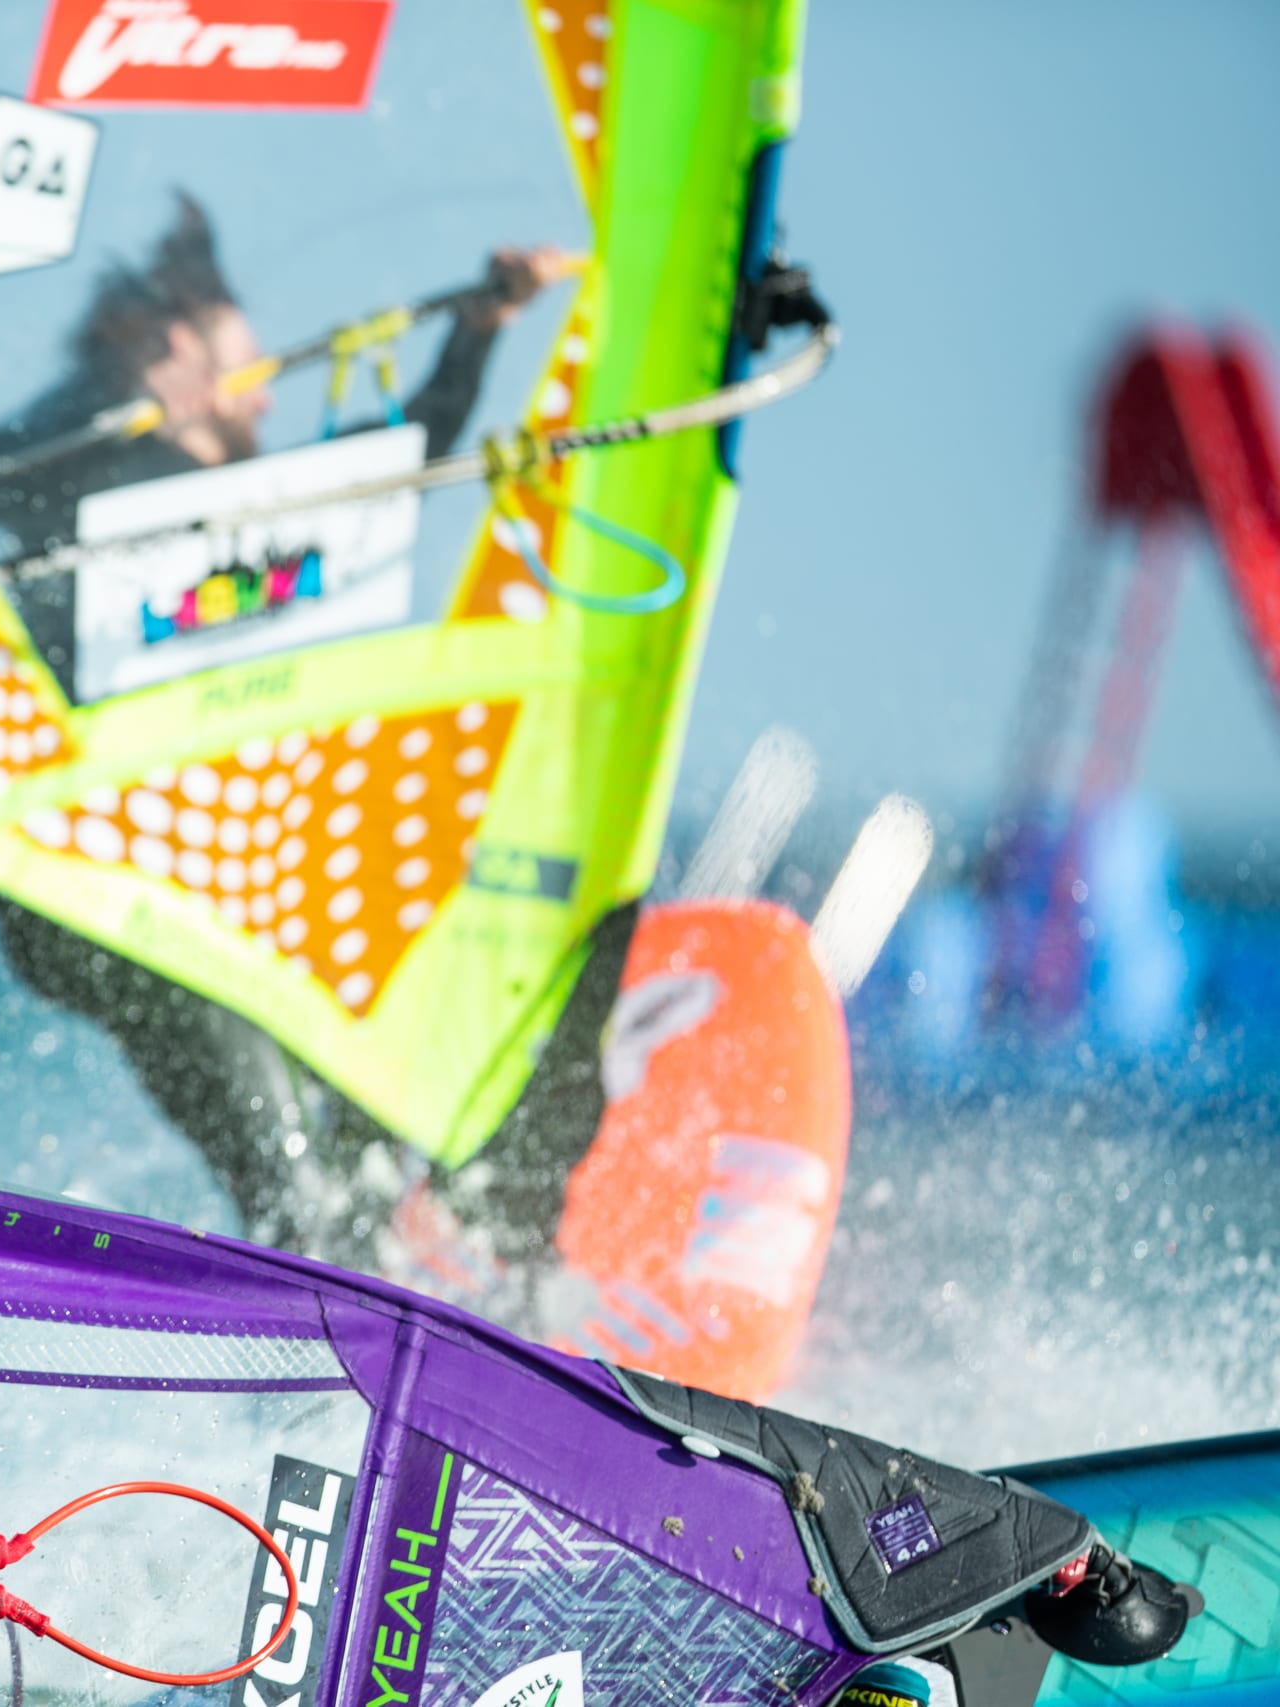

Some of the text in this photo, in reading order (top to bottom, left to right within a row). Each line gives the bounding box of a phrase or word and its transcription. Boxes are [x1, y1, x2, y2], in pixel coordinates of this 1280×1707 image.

[875, 1503, 916, 1528] YEAH
[896, 1539, 930, 1561] 4.4
[503, 1674, 554, 1707] STYLE
